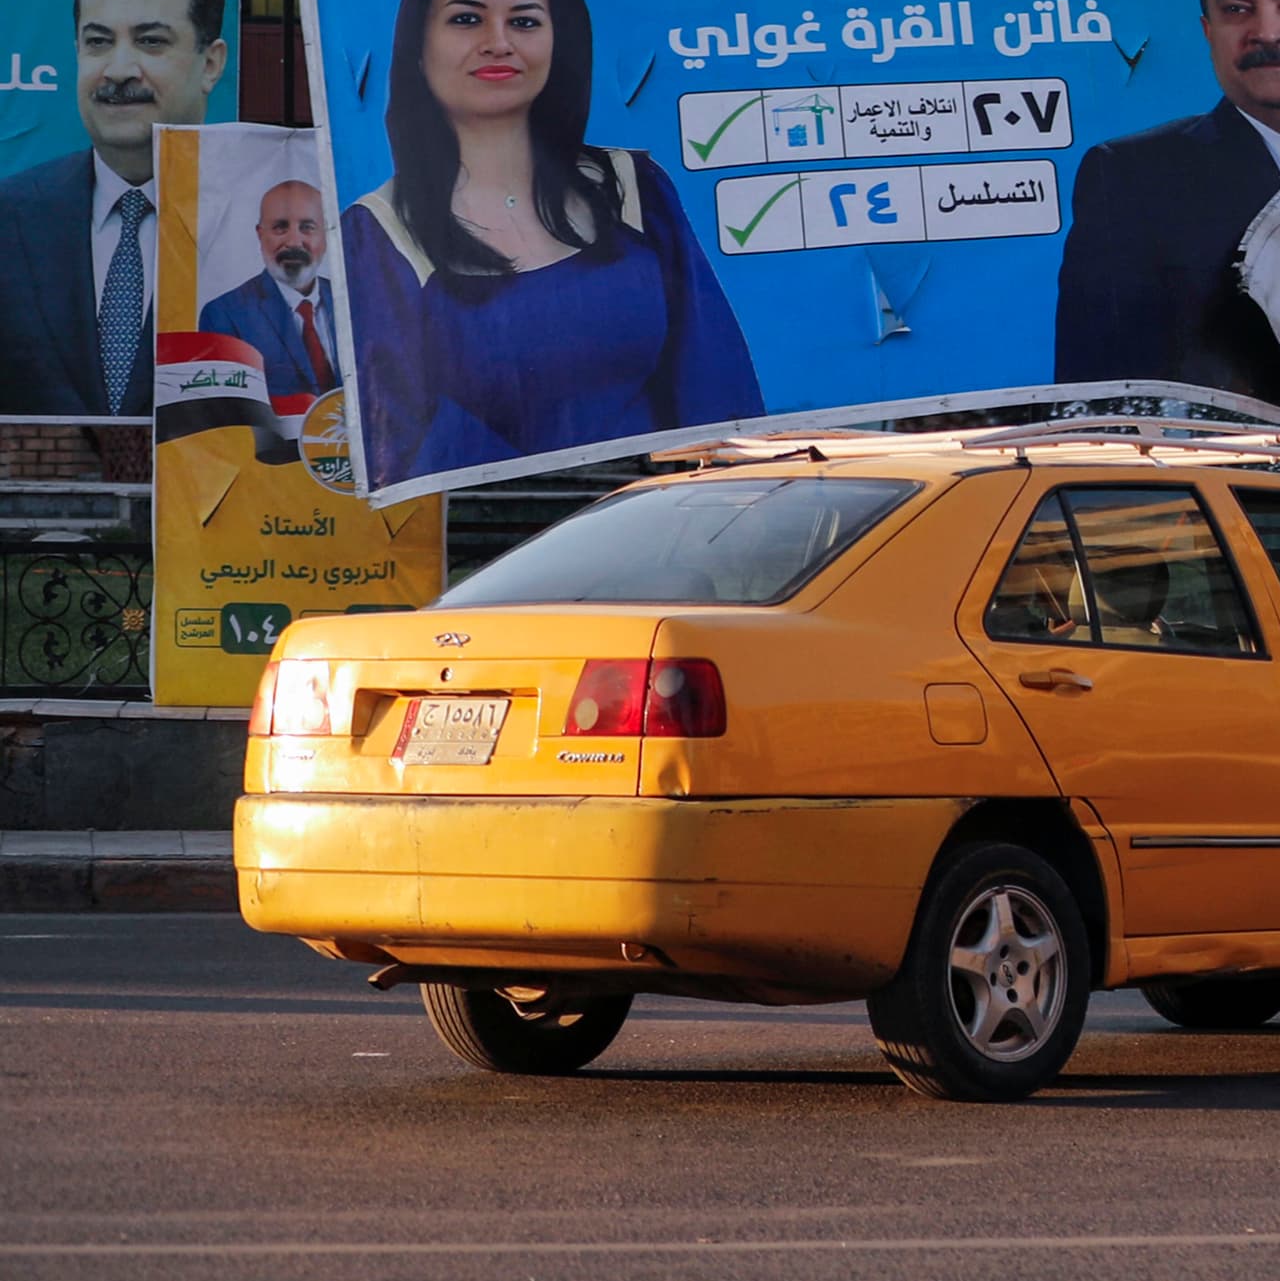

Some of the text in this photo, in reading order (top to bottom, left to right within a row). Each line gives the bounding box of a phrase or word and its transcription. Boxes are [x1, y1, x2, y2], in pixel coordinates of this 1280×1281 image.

[667, 10, 827, 69] غولي
[841, 0, 975, 65] القرة
[848, 97, 958, 124] ائتلاف الاعمار
[972, 90, 1061, 136] ٢٠٧
[827, 181, 898, 228] ٢٤
[938, 180, 1045, 214] التسلسل
[258, 508, 336, 538] الأستاذ
[200, 559, 396, 594] التربوي رعد الربيعي
[228, 613, 280, 646] ١٠٤
